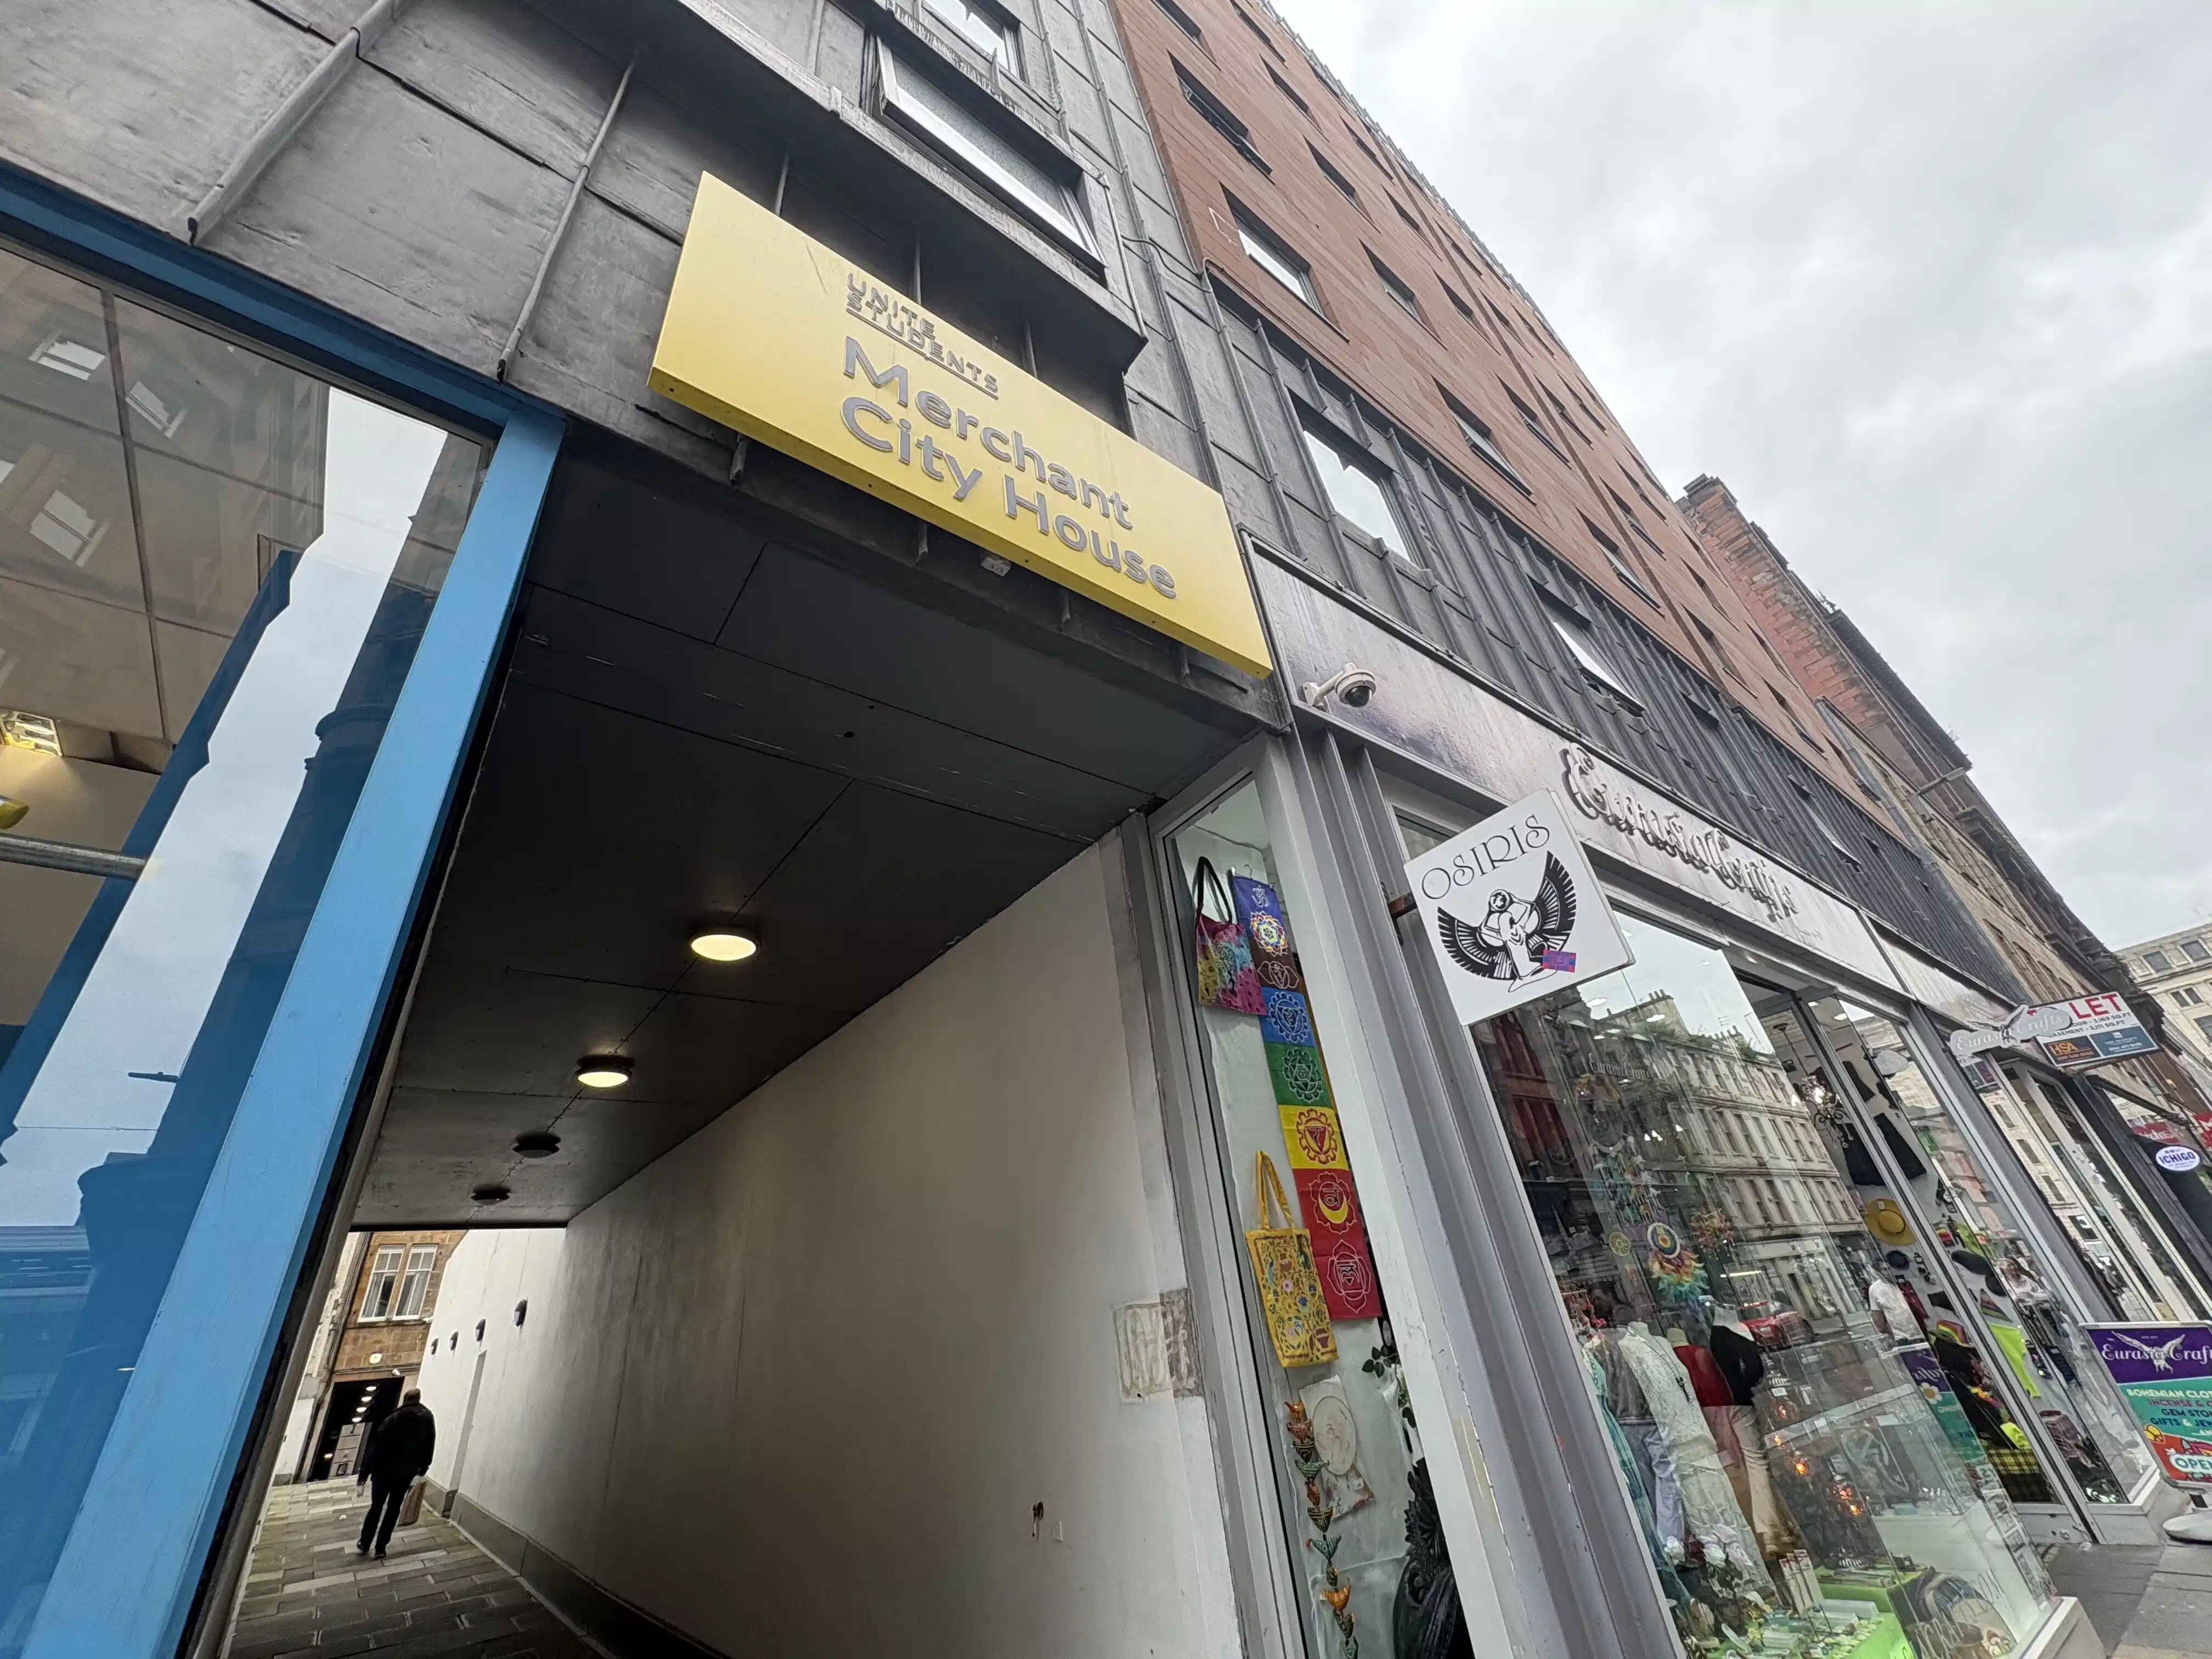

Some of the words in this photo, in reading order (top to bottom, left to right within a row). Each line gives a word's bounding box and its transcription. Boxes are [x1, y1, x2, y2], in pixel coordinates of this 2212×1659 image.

[848, 273, 936, 340] UNITE
[847, 292, 998, 393] STUDENTS
[843, 336, 1133, 530] Merchant
[841, 397, 983, 501] City
[1003, 474, 1177, 599] House
[1421, 813, 1550, 900] OSIRIS
[2068, 994, 2123, 1019] LET
[2053, 1027, 2084, 1036] ASEMENT
[2049, 1041, 2079, 1056] HSA
[2158, 1152, 2196, 1164] ICHIGO
[2102, 1343, 2164, 1361] Eurasia
[2126, 1389, 2185, 1398] BOHEMIAN
[2162, 1408, 2186, 1417] GEM
[2150, 1418, 2181, 1426] GIFTS
